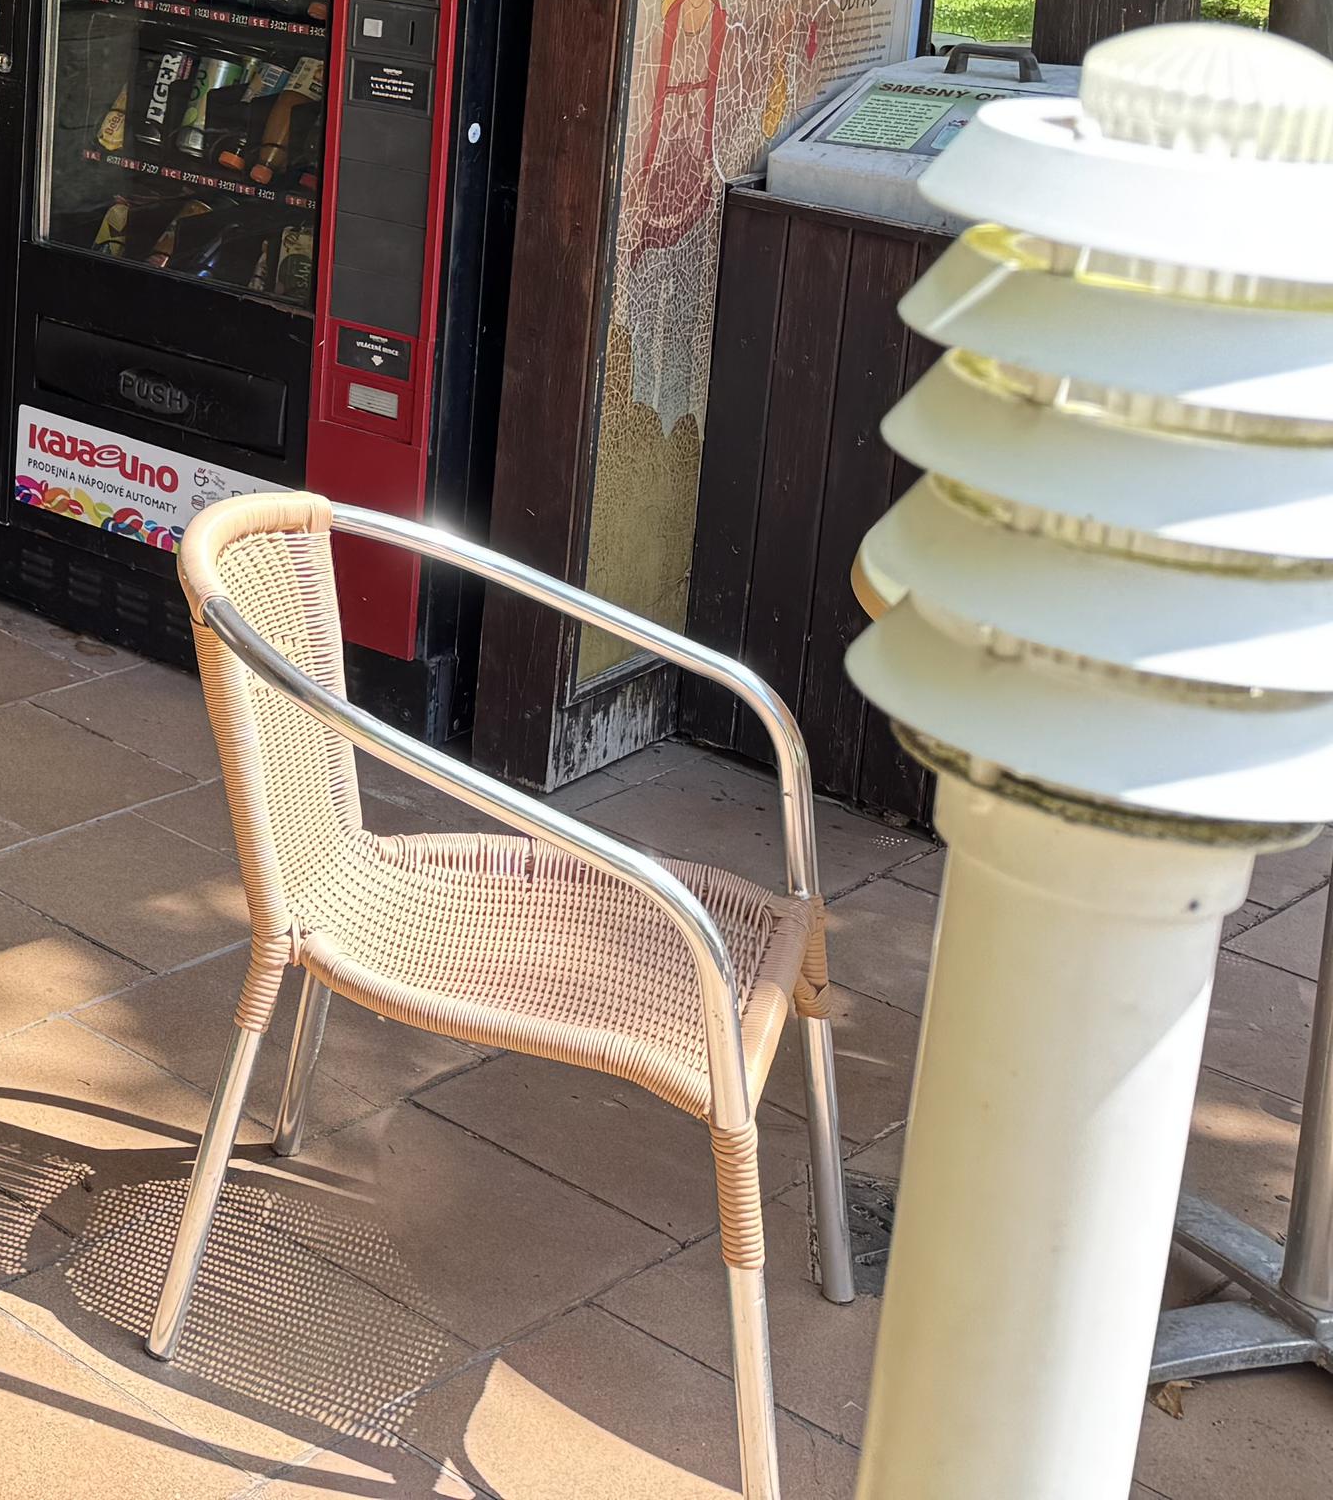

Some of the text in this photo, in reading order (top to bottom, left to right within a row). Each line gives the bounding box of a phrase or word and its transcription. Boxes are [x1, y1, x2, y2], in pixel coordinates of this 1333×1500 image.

[120, 374, 183, 411] PUSH
[27, 458, 69, 481] PRODEJNÍ
[69, 472, 76, 482] A
[78, 472, 125, 498] NÁPOJOVÉ
[125, 491, 178, 515] AUTOMATY
